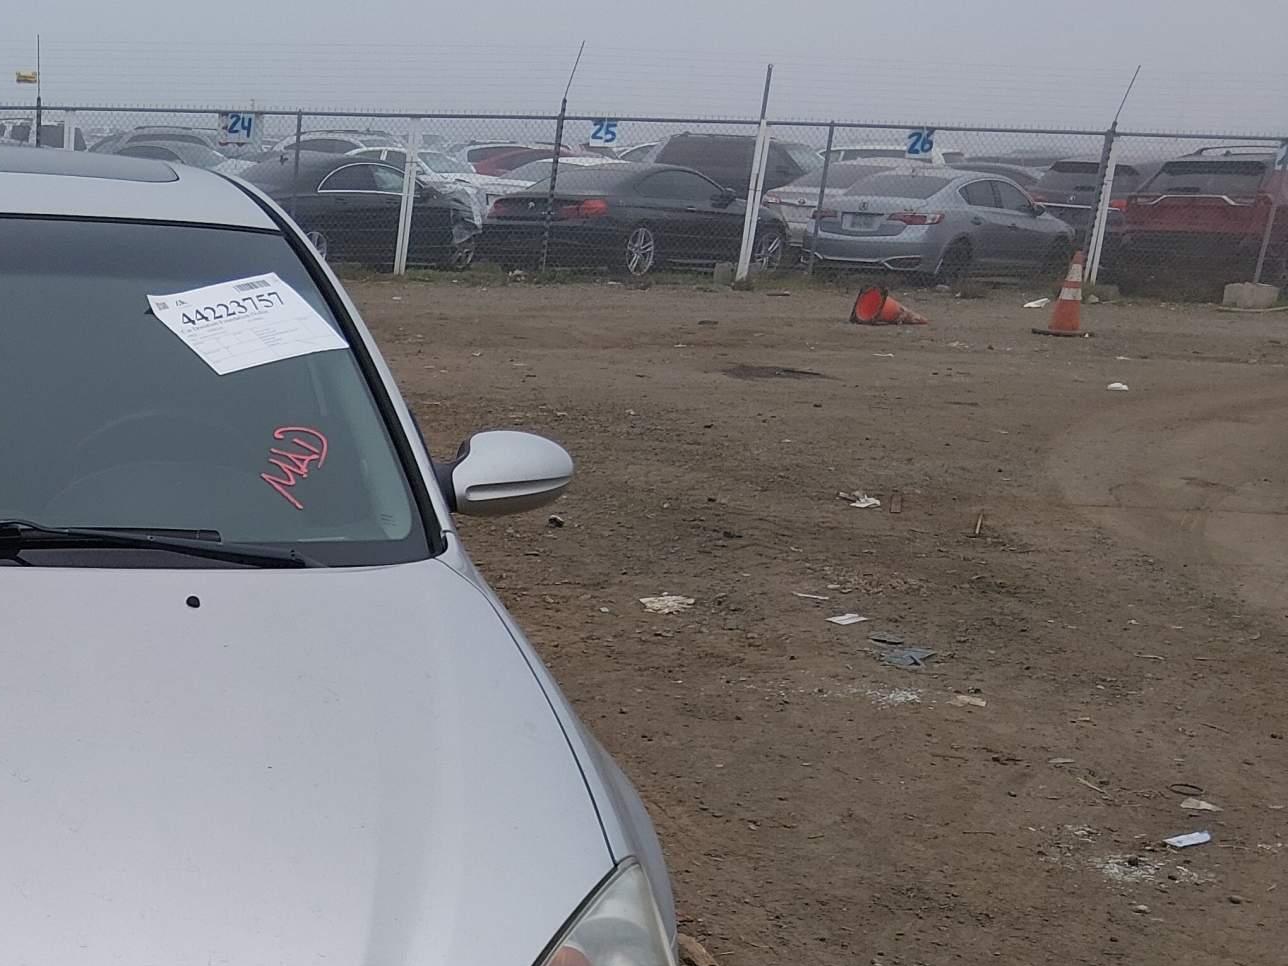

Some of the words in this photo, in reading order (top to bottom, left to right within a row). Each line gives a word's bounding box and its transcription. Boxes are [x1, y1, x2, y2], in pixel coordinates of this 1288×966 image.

[227, 114, 252, 138] 24
[590, 122, 617, 143] 25
[907, 131, 934, 154] 26
[181, 291, 284, 326] 44223757
